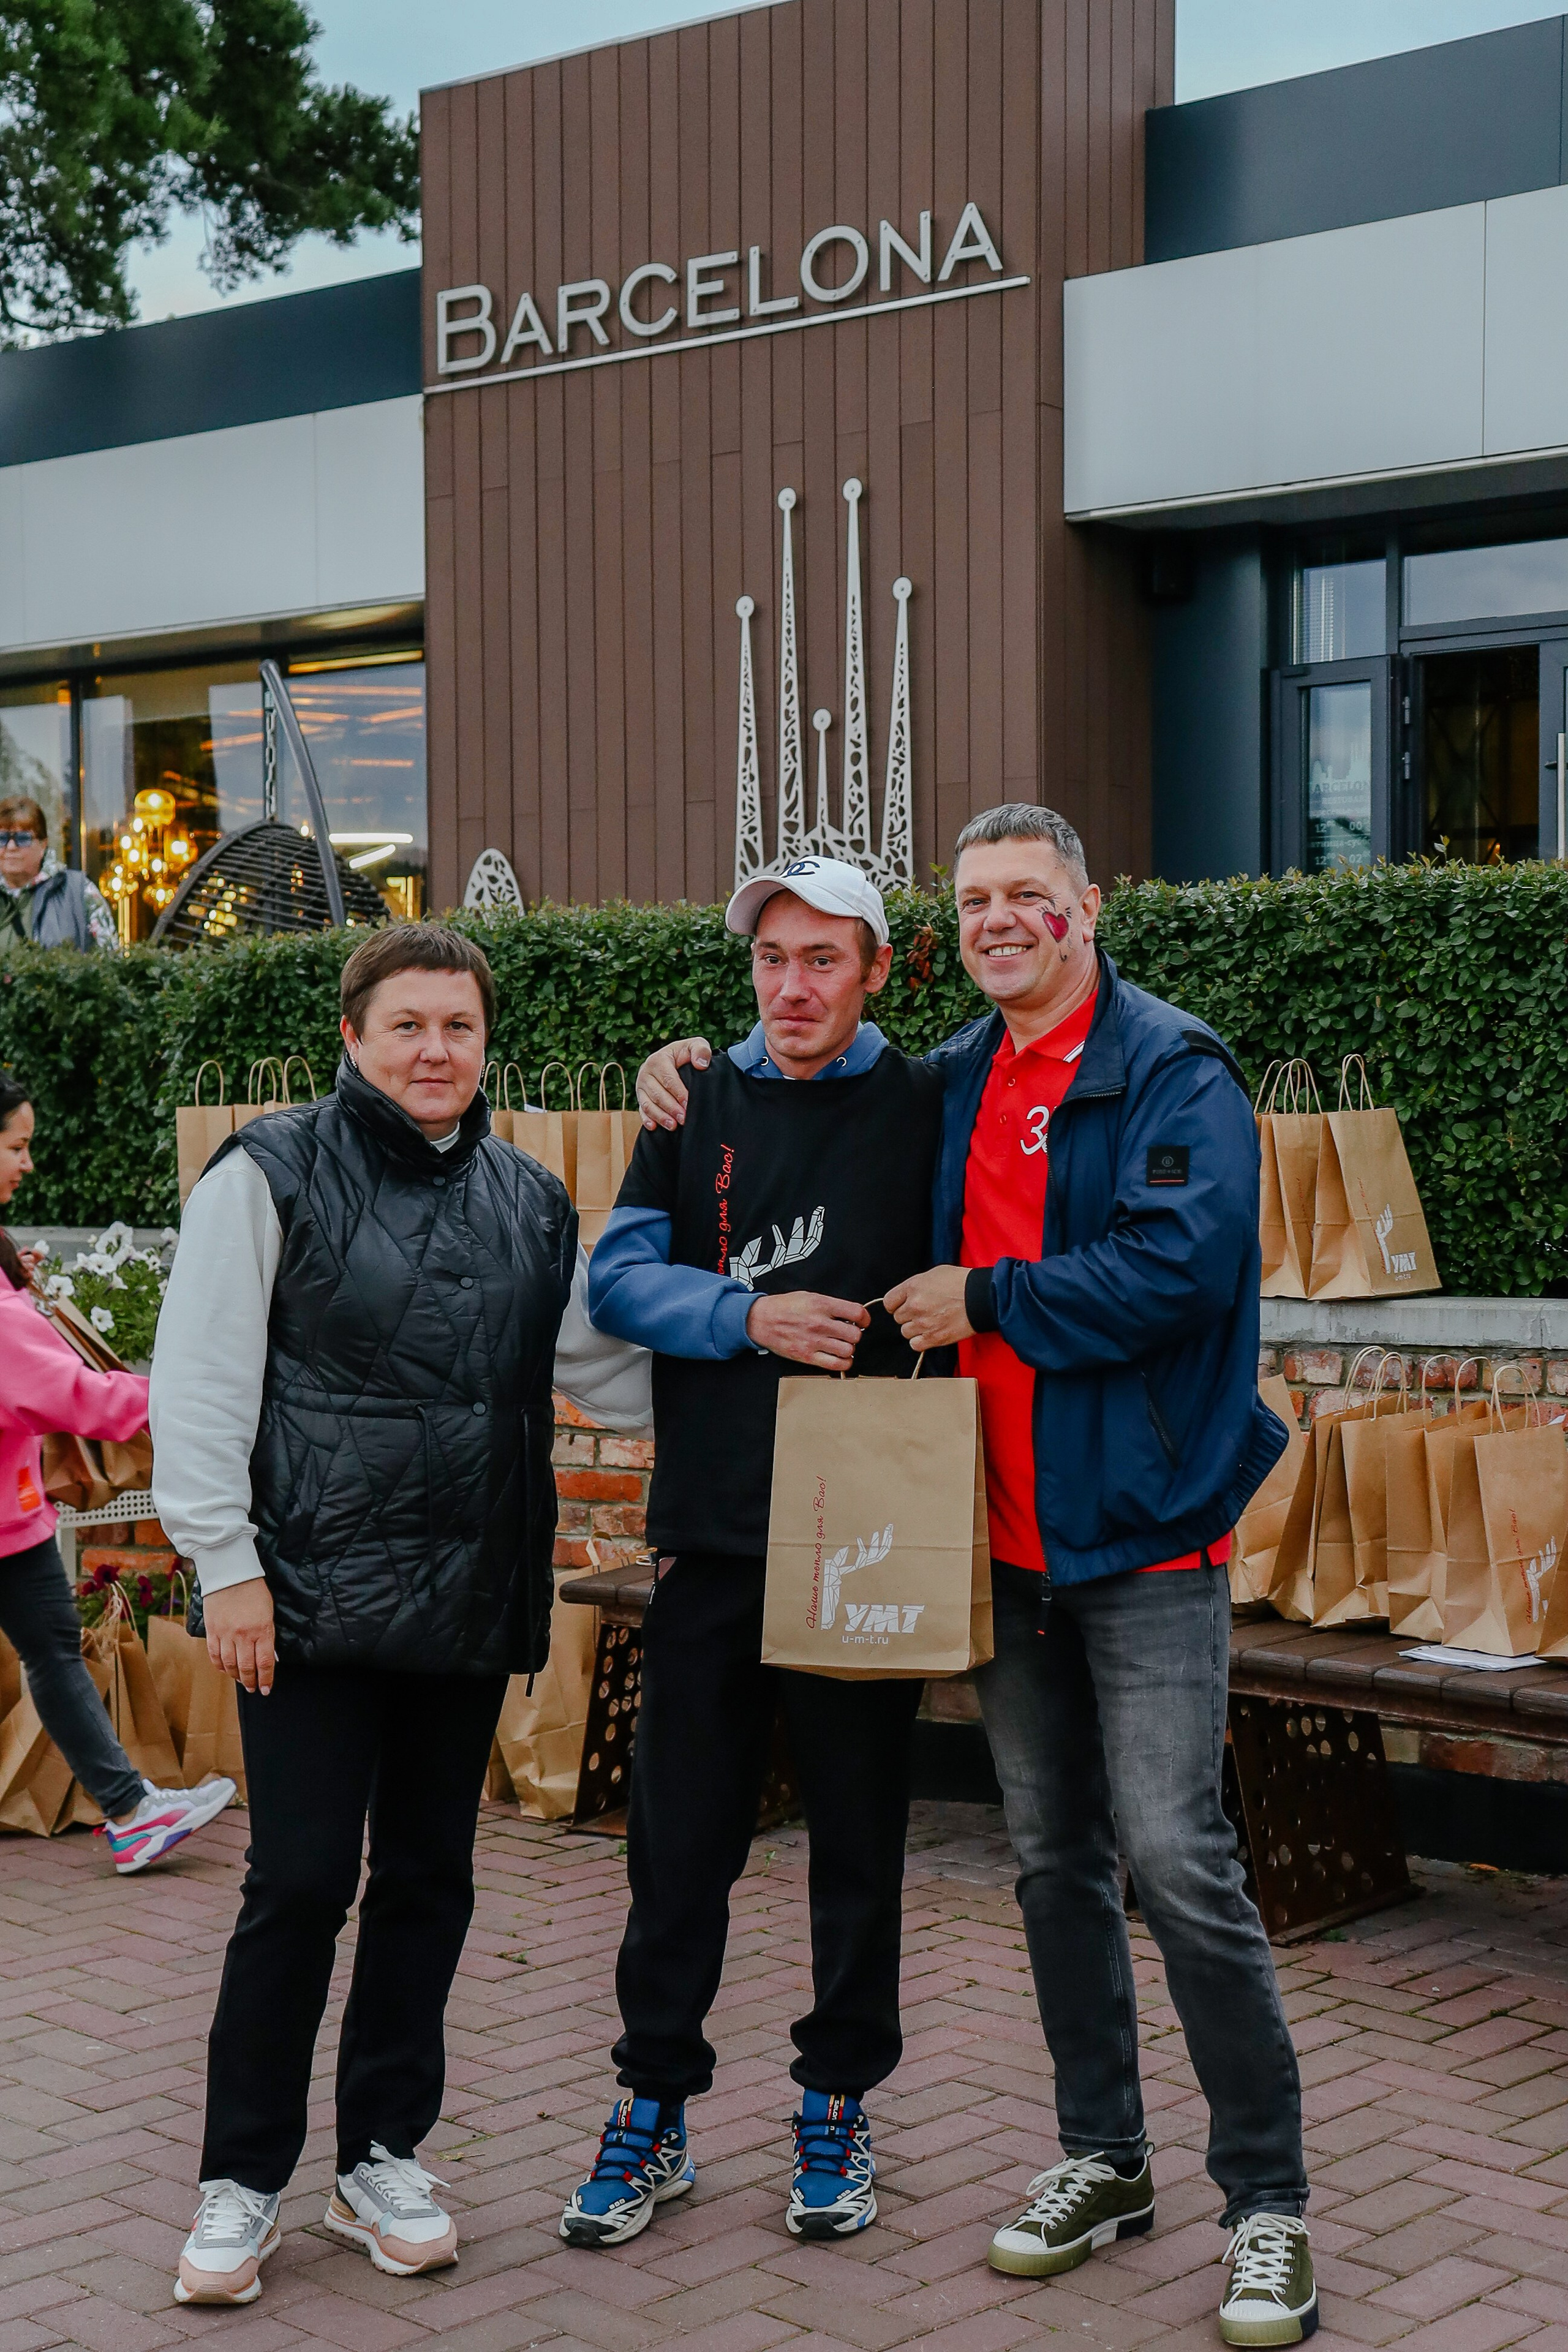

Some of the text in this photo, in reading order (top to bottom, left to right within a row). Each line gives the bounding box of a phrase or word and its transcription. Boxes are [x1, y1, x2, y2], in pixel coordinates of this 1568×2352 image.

[437, 202, 1003, 374] BARCELONA
[715, 1144, 734, 1194] Вас!
[717, 1236, 728, 1275] епло
[806, 1475, 827, 1629] Наше тепло для Вас!
[842, 1635, 889, 1645] u-m-t.ru
[844, 1604, 925, 1634] УМТ
